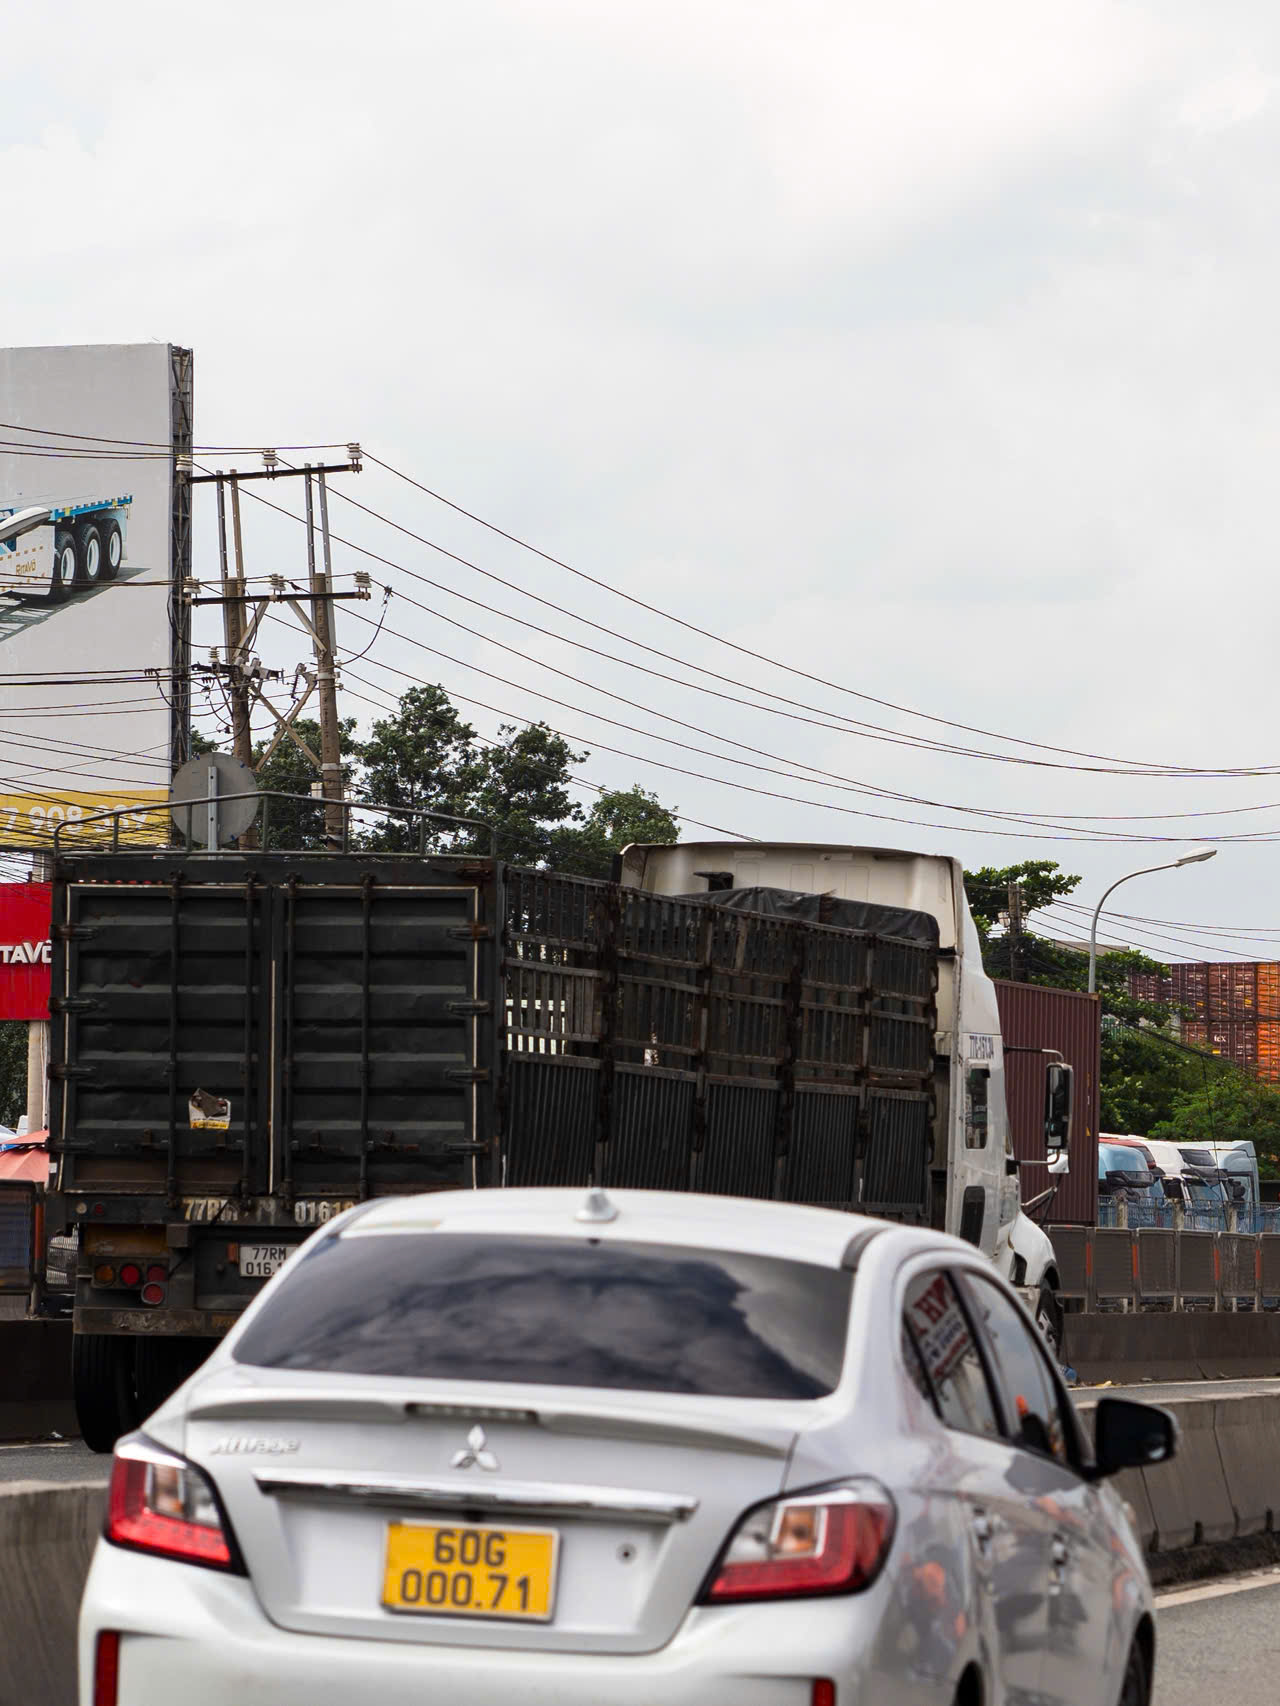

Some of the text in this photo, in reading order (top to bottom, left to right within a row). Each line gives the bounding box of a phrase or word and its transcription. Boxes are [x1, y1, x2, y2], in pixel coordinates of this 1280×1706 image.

[252, 1247, 287, 1260] 77RM
[433, 1529, 507, 1567] 60G
[401, 1569, 531, 1612] 000.71
